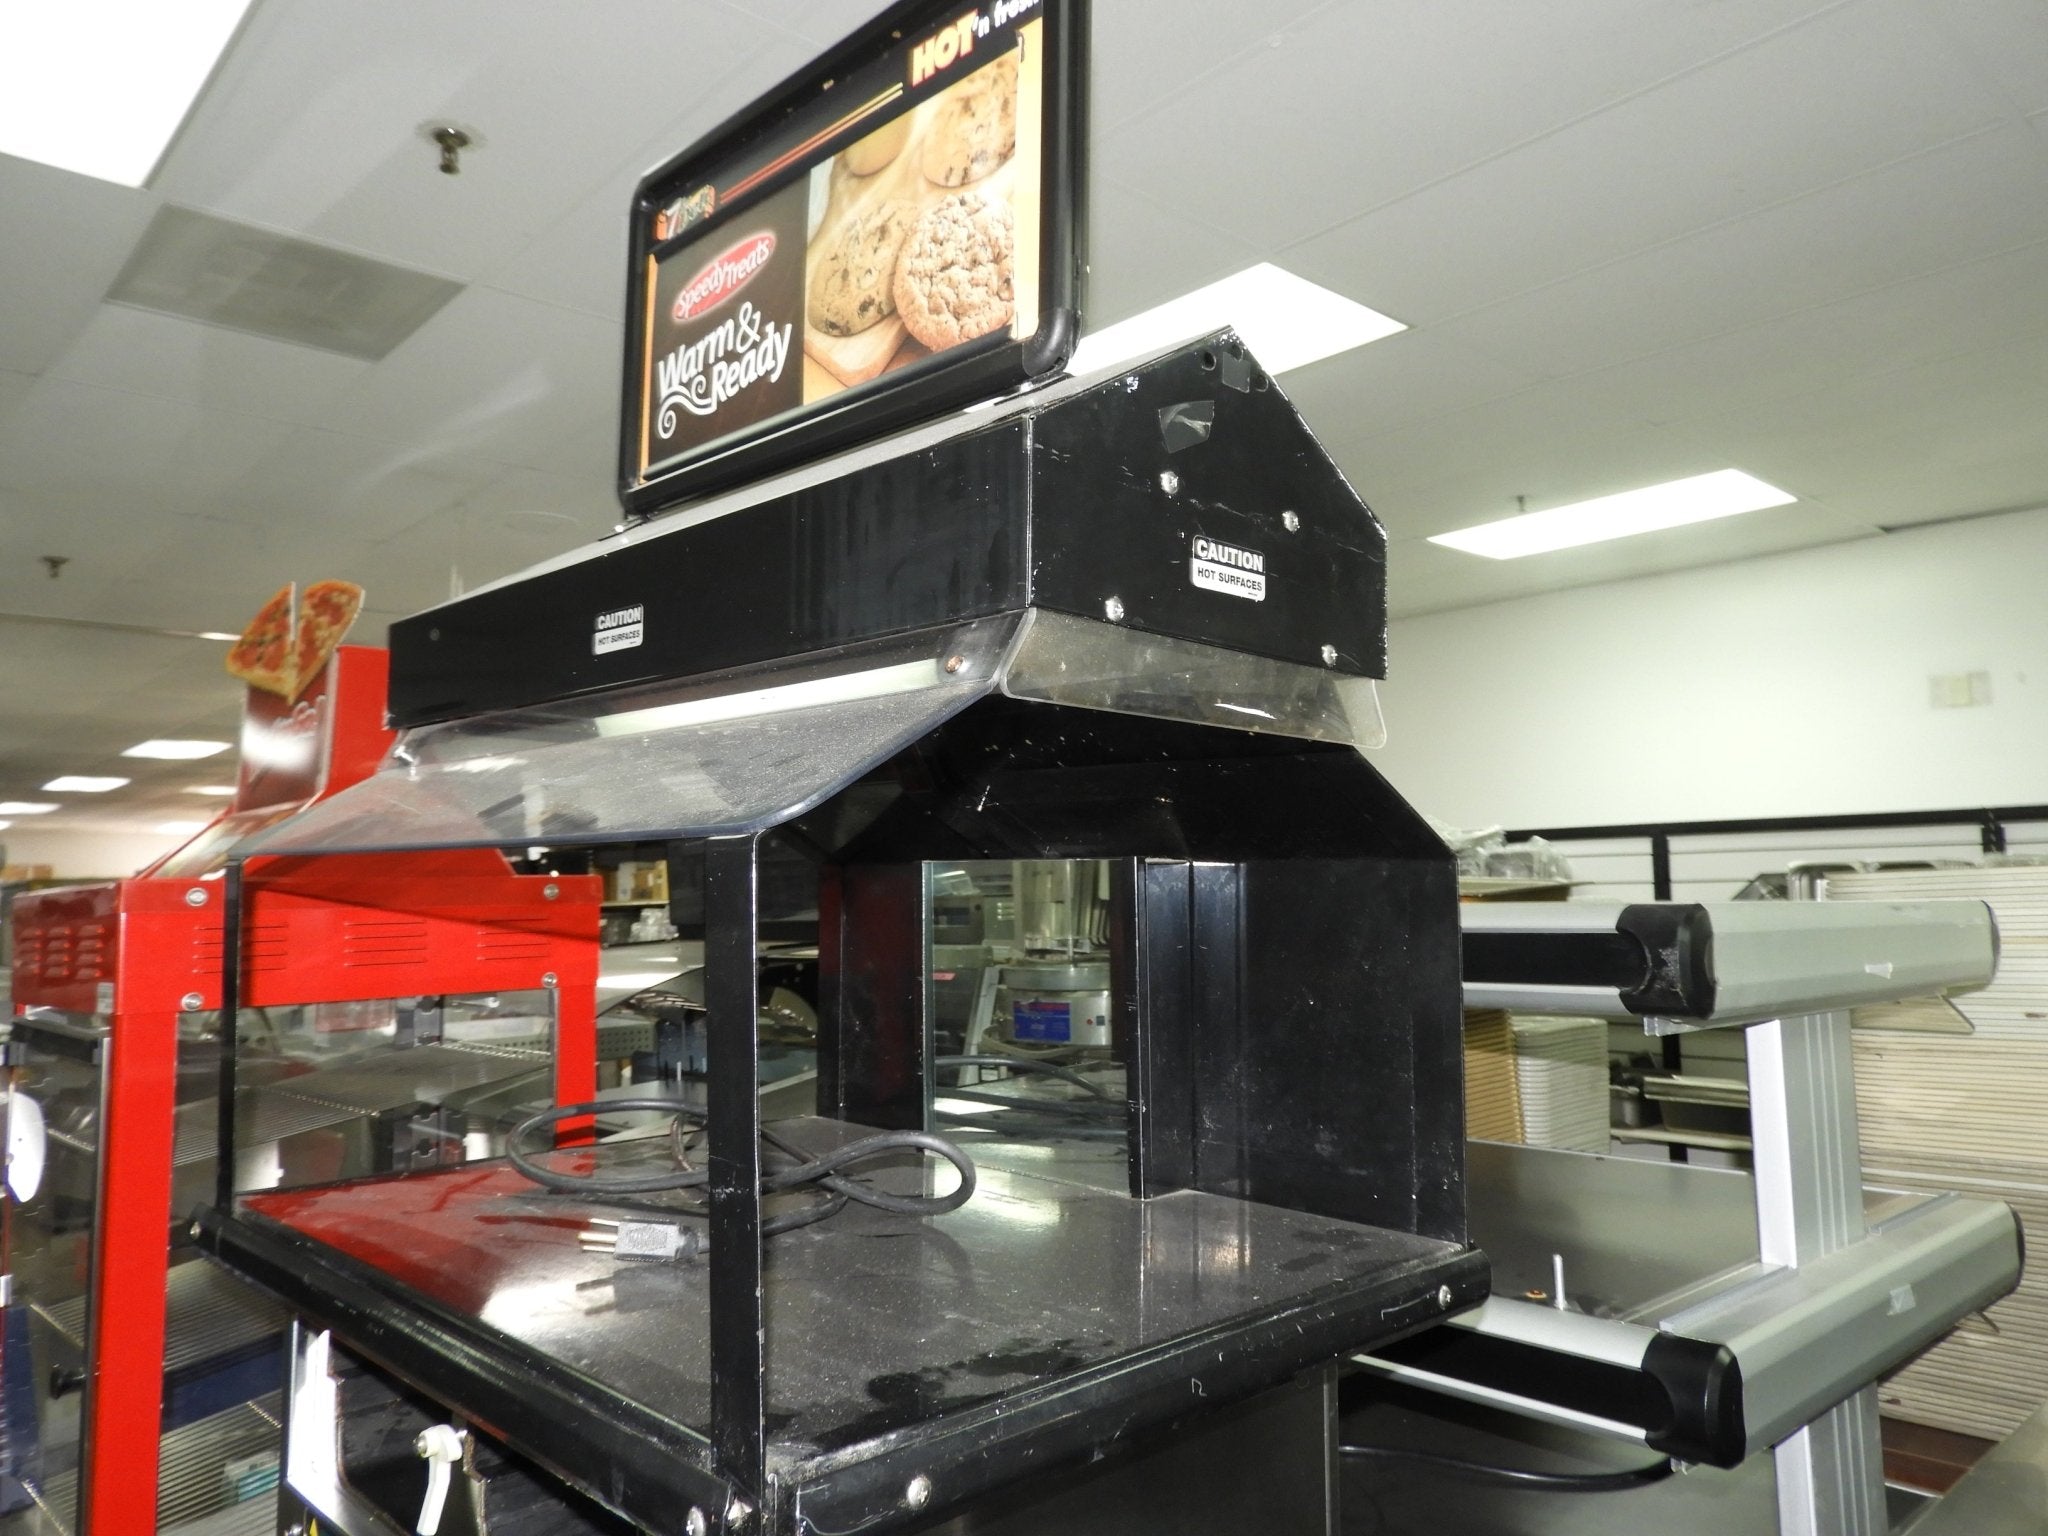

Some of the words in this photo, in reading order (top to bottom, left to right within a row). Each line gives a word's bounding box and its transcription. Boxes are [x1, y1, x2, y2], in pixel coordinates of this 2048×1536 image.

[912, 8, 978, 88] HOT
[994, 0, 1040, 28] fres
[711, 321, 792, 402] Ready
[1197, 539, 1263, 573] CAUTION
[1197, 567, 1216, 580] HOT
[1218, 572, 1262, 592] SURFACES
[598, 606, 641, 630] CAUTION
[611, 629, 640, 643] SURFACES
